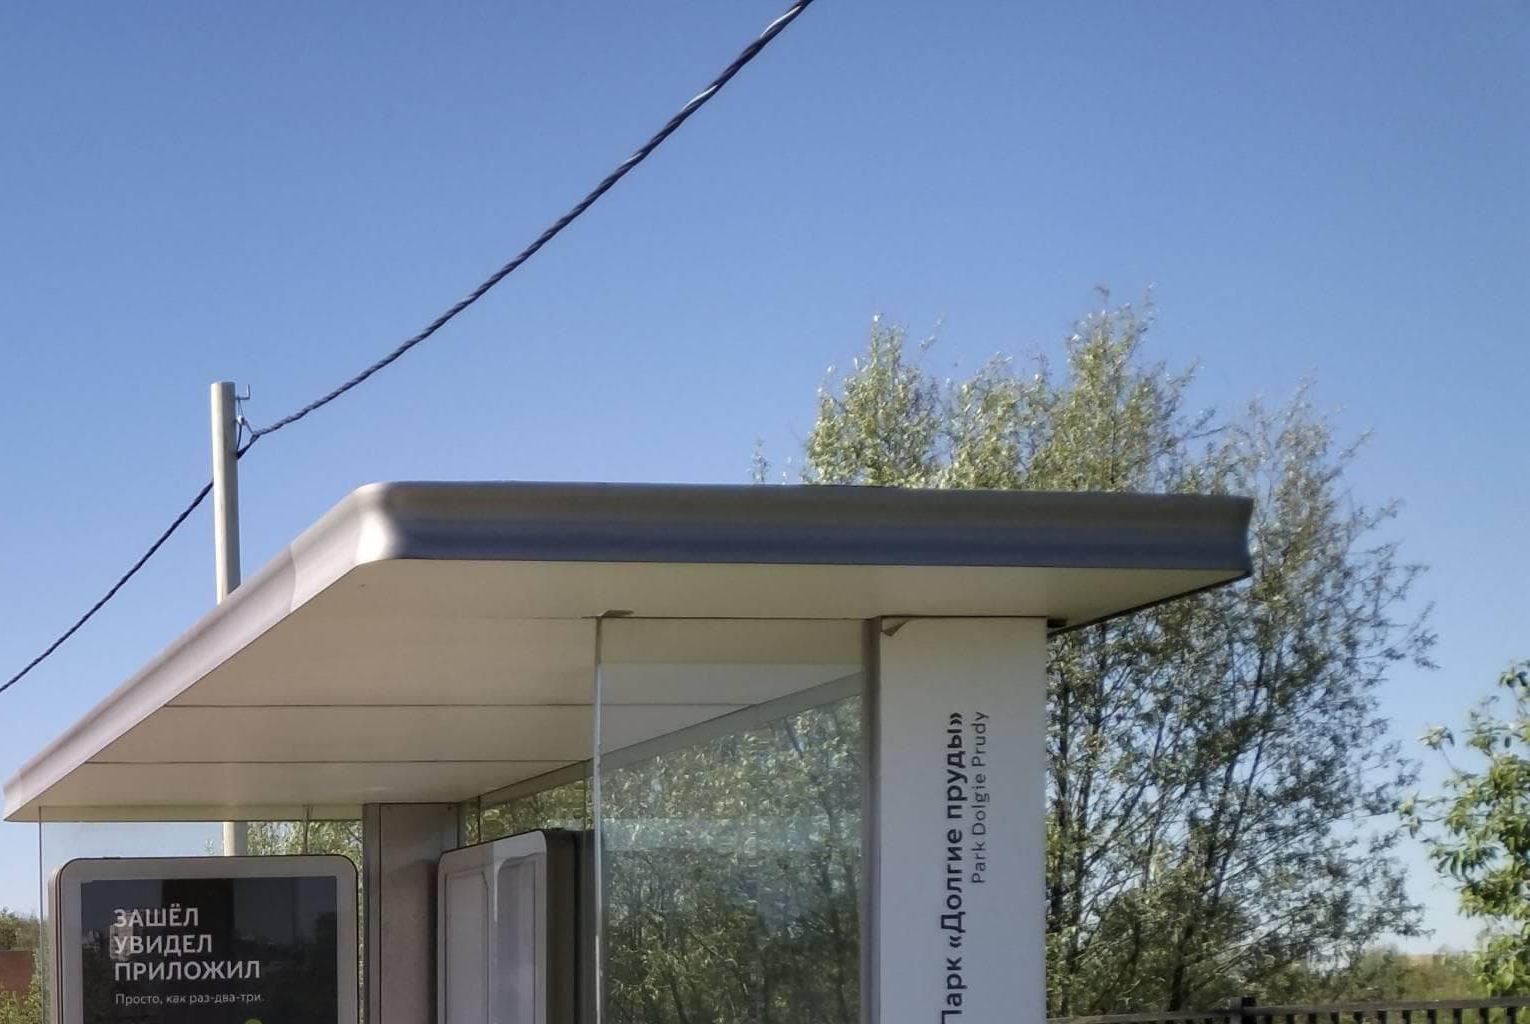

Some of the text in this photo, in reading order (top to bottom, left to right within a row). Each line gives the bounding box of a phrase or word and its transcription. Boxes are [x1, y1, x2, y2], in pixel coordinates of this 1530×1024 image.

[946, 712, 968, 819] пруды»
[970, 711, 990, 883] Park Dolgie Prudy
[940, 827, 966, 949] «Долгие
[114, 903, 198, 928] ЗАШЁЛ
[114, 934, 213, 957] УВИДЕЛ
[115, 960, 261, 981] ПРИЛОЖИЛ
[115, 992, 264, 1006] Просто, как раз-два-три.
